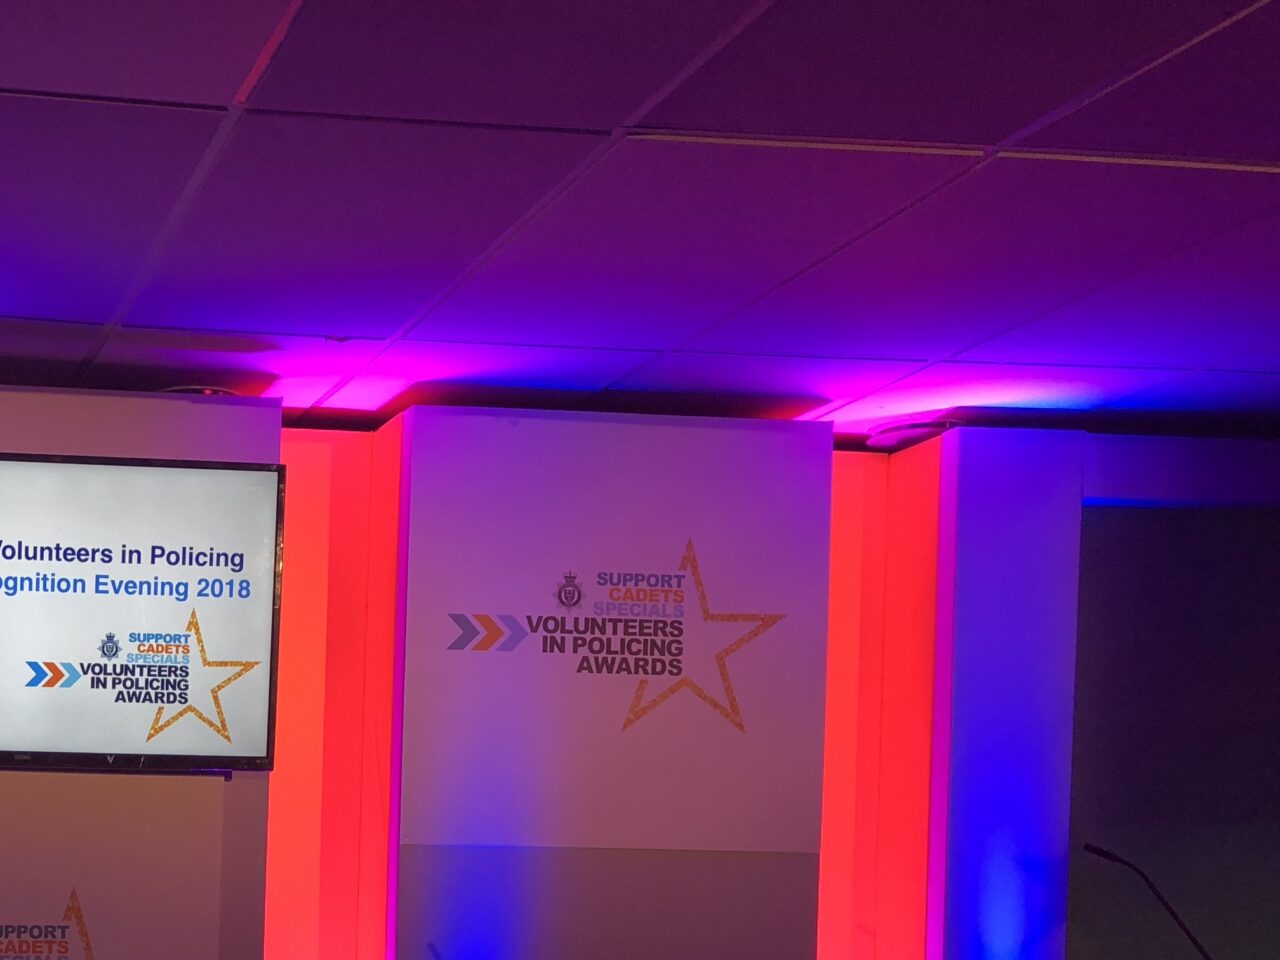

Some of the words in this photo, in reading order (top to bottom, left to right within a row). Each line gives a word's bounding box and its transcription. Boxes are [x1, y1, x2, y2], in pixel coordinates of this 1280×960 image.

[121, 544, 141, 564] in
[150, 545, 244, 573] Policing
[94, 574, 189, 602] Evening
[196, 578, 251, 599] 2018
[596, 572, 686, 589] SUPPORT
[608, 587, 685, 604] CADETS
[592, 601, 685, 619] SPECIALS
[526, 615, 684, 638] VOLUNTEERS
[129, 632, 191, 644] SUPPORT
[541, 635, 565, 654] IN
[572, 636, 683, 657] POLICING
[137, 644, 190, 654] CADETS
[126, 653, 190, 665] SPECIALS
[576, 656, 683, 676] AWARDS
[80, 662, 189, 678] VOLUNTEERS
[90, 677, 107, 689] IN
[112, 677, 189, 691] POLICING
[114, 691, 188, 704] AWARDS
